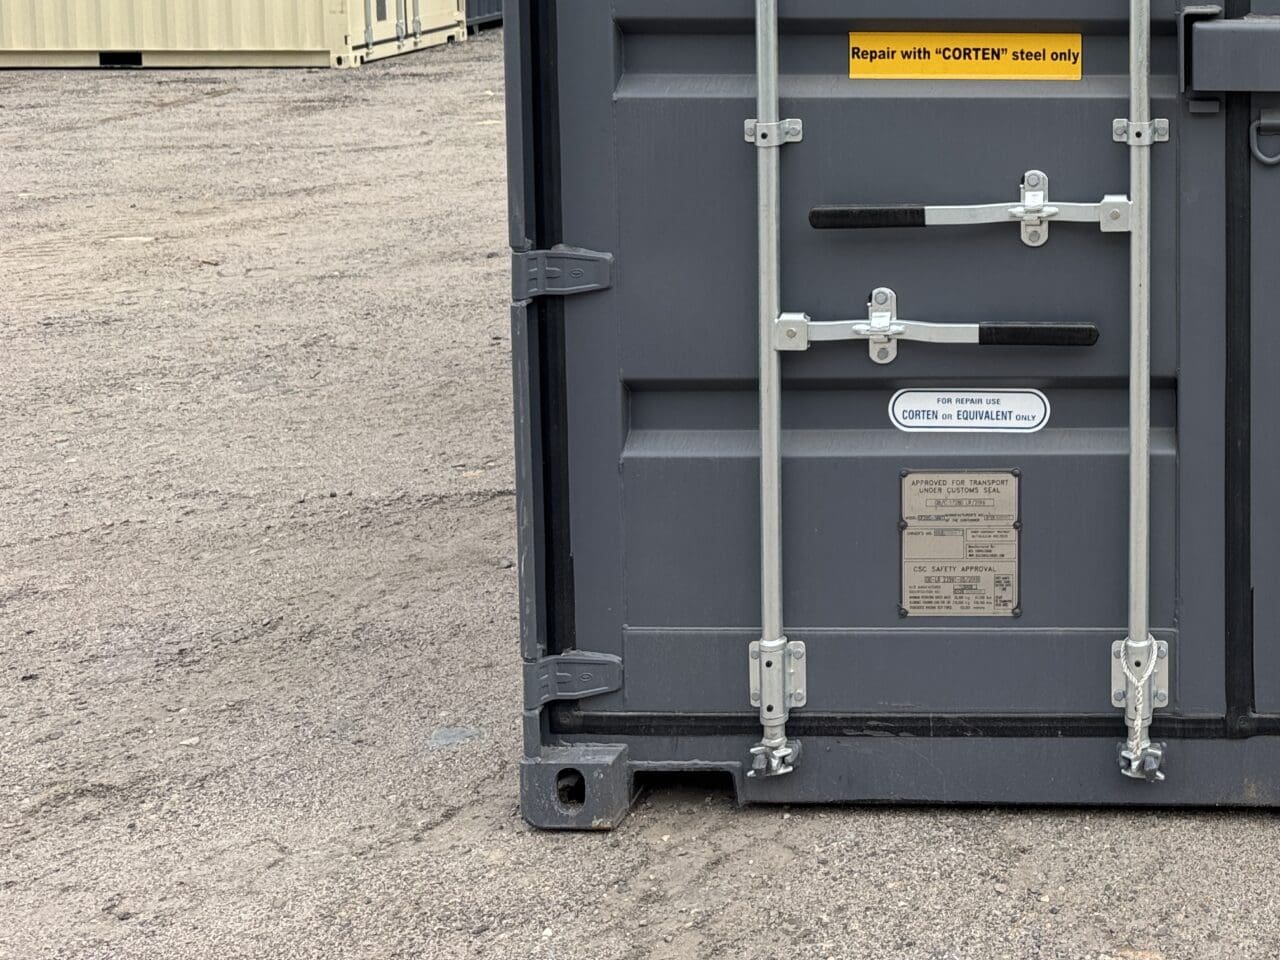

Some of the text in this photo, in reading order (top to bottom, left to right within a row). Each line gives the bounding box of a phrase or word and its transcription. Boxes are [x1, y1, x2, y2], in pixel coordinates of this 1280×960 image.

[852, 47, 896, 62] Repair
[901, 47, 930, 60] with
[1012, 49, 1046, 61] steel
[1051, 49, 1079, 64] only
[903, 410, 938, 420] CORTEN
[957, 410, 1013, 421] EQUIVALENT
